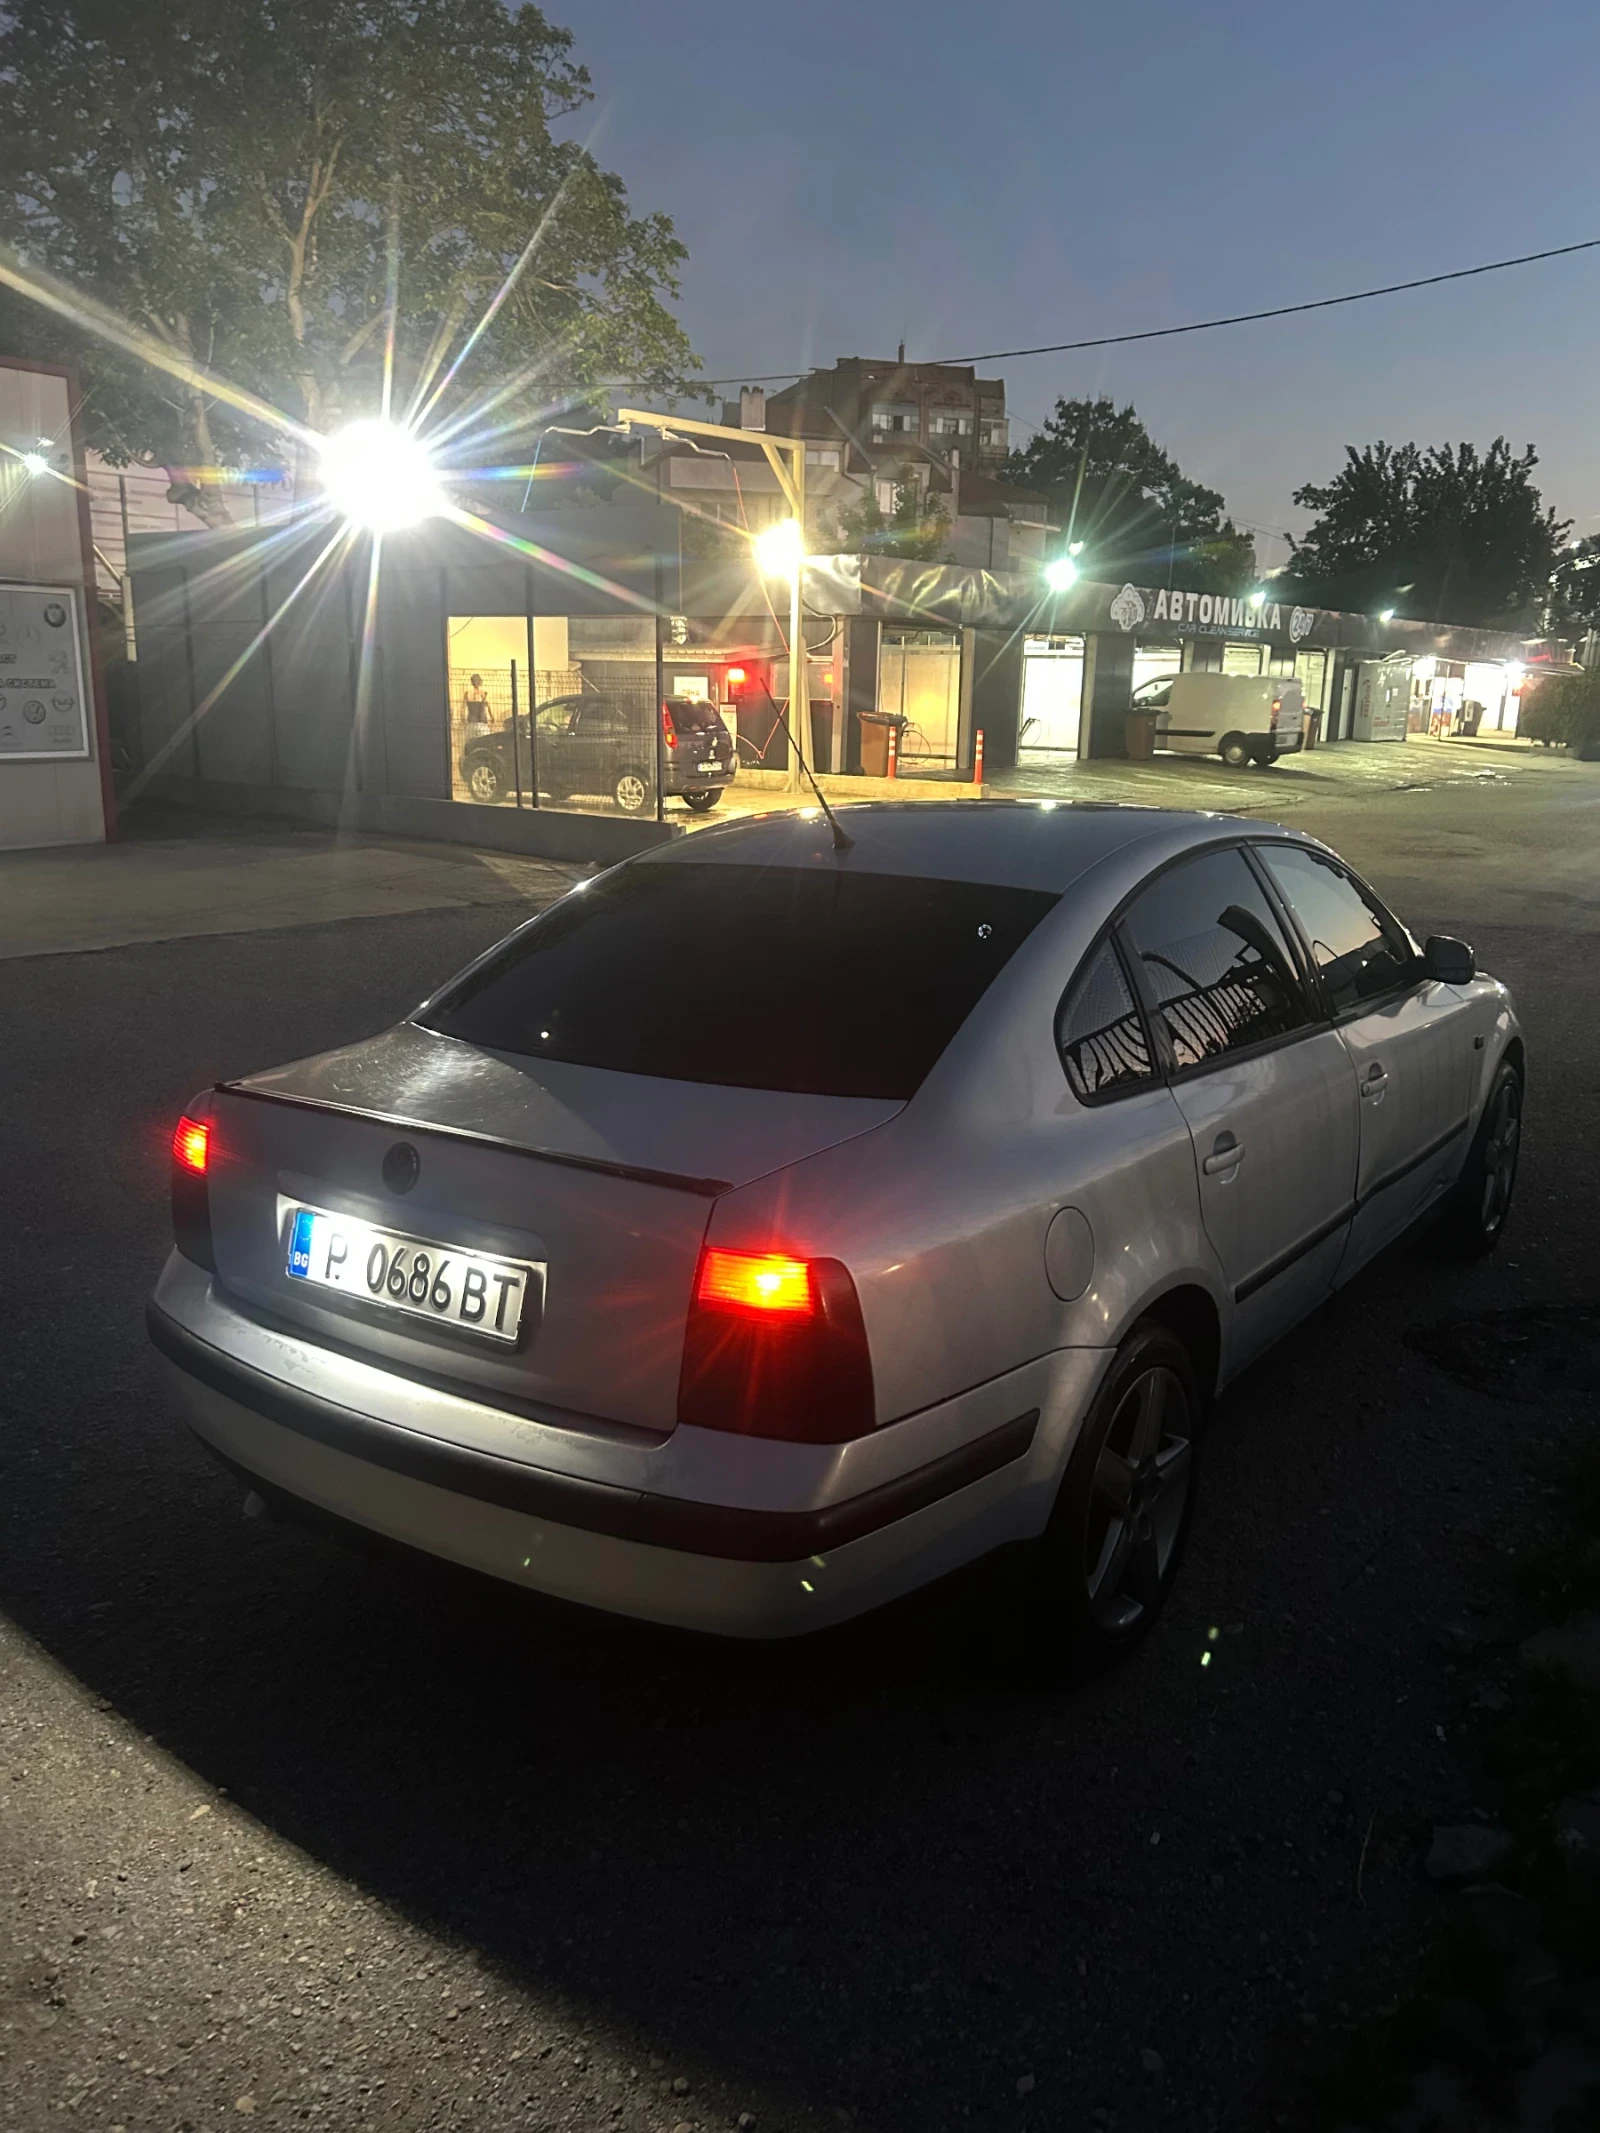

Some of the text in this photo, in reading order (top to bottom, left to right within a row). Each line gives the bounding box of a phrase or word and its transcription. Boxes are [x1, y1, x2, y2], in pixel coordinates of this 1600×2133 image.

[1153, 589, 1281, 630] АВТОМИВКА
[1177, 623, 1260, 638] CAR CLEAN SERVICE
[293, 1251, 309, 1269] BG
[325, 1232, 349, 1280] P
